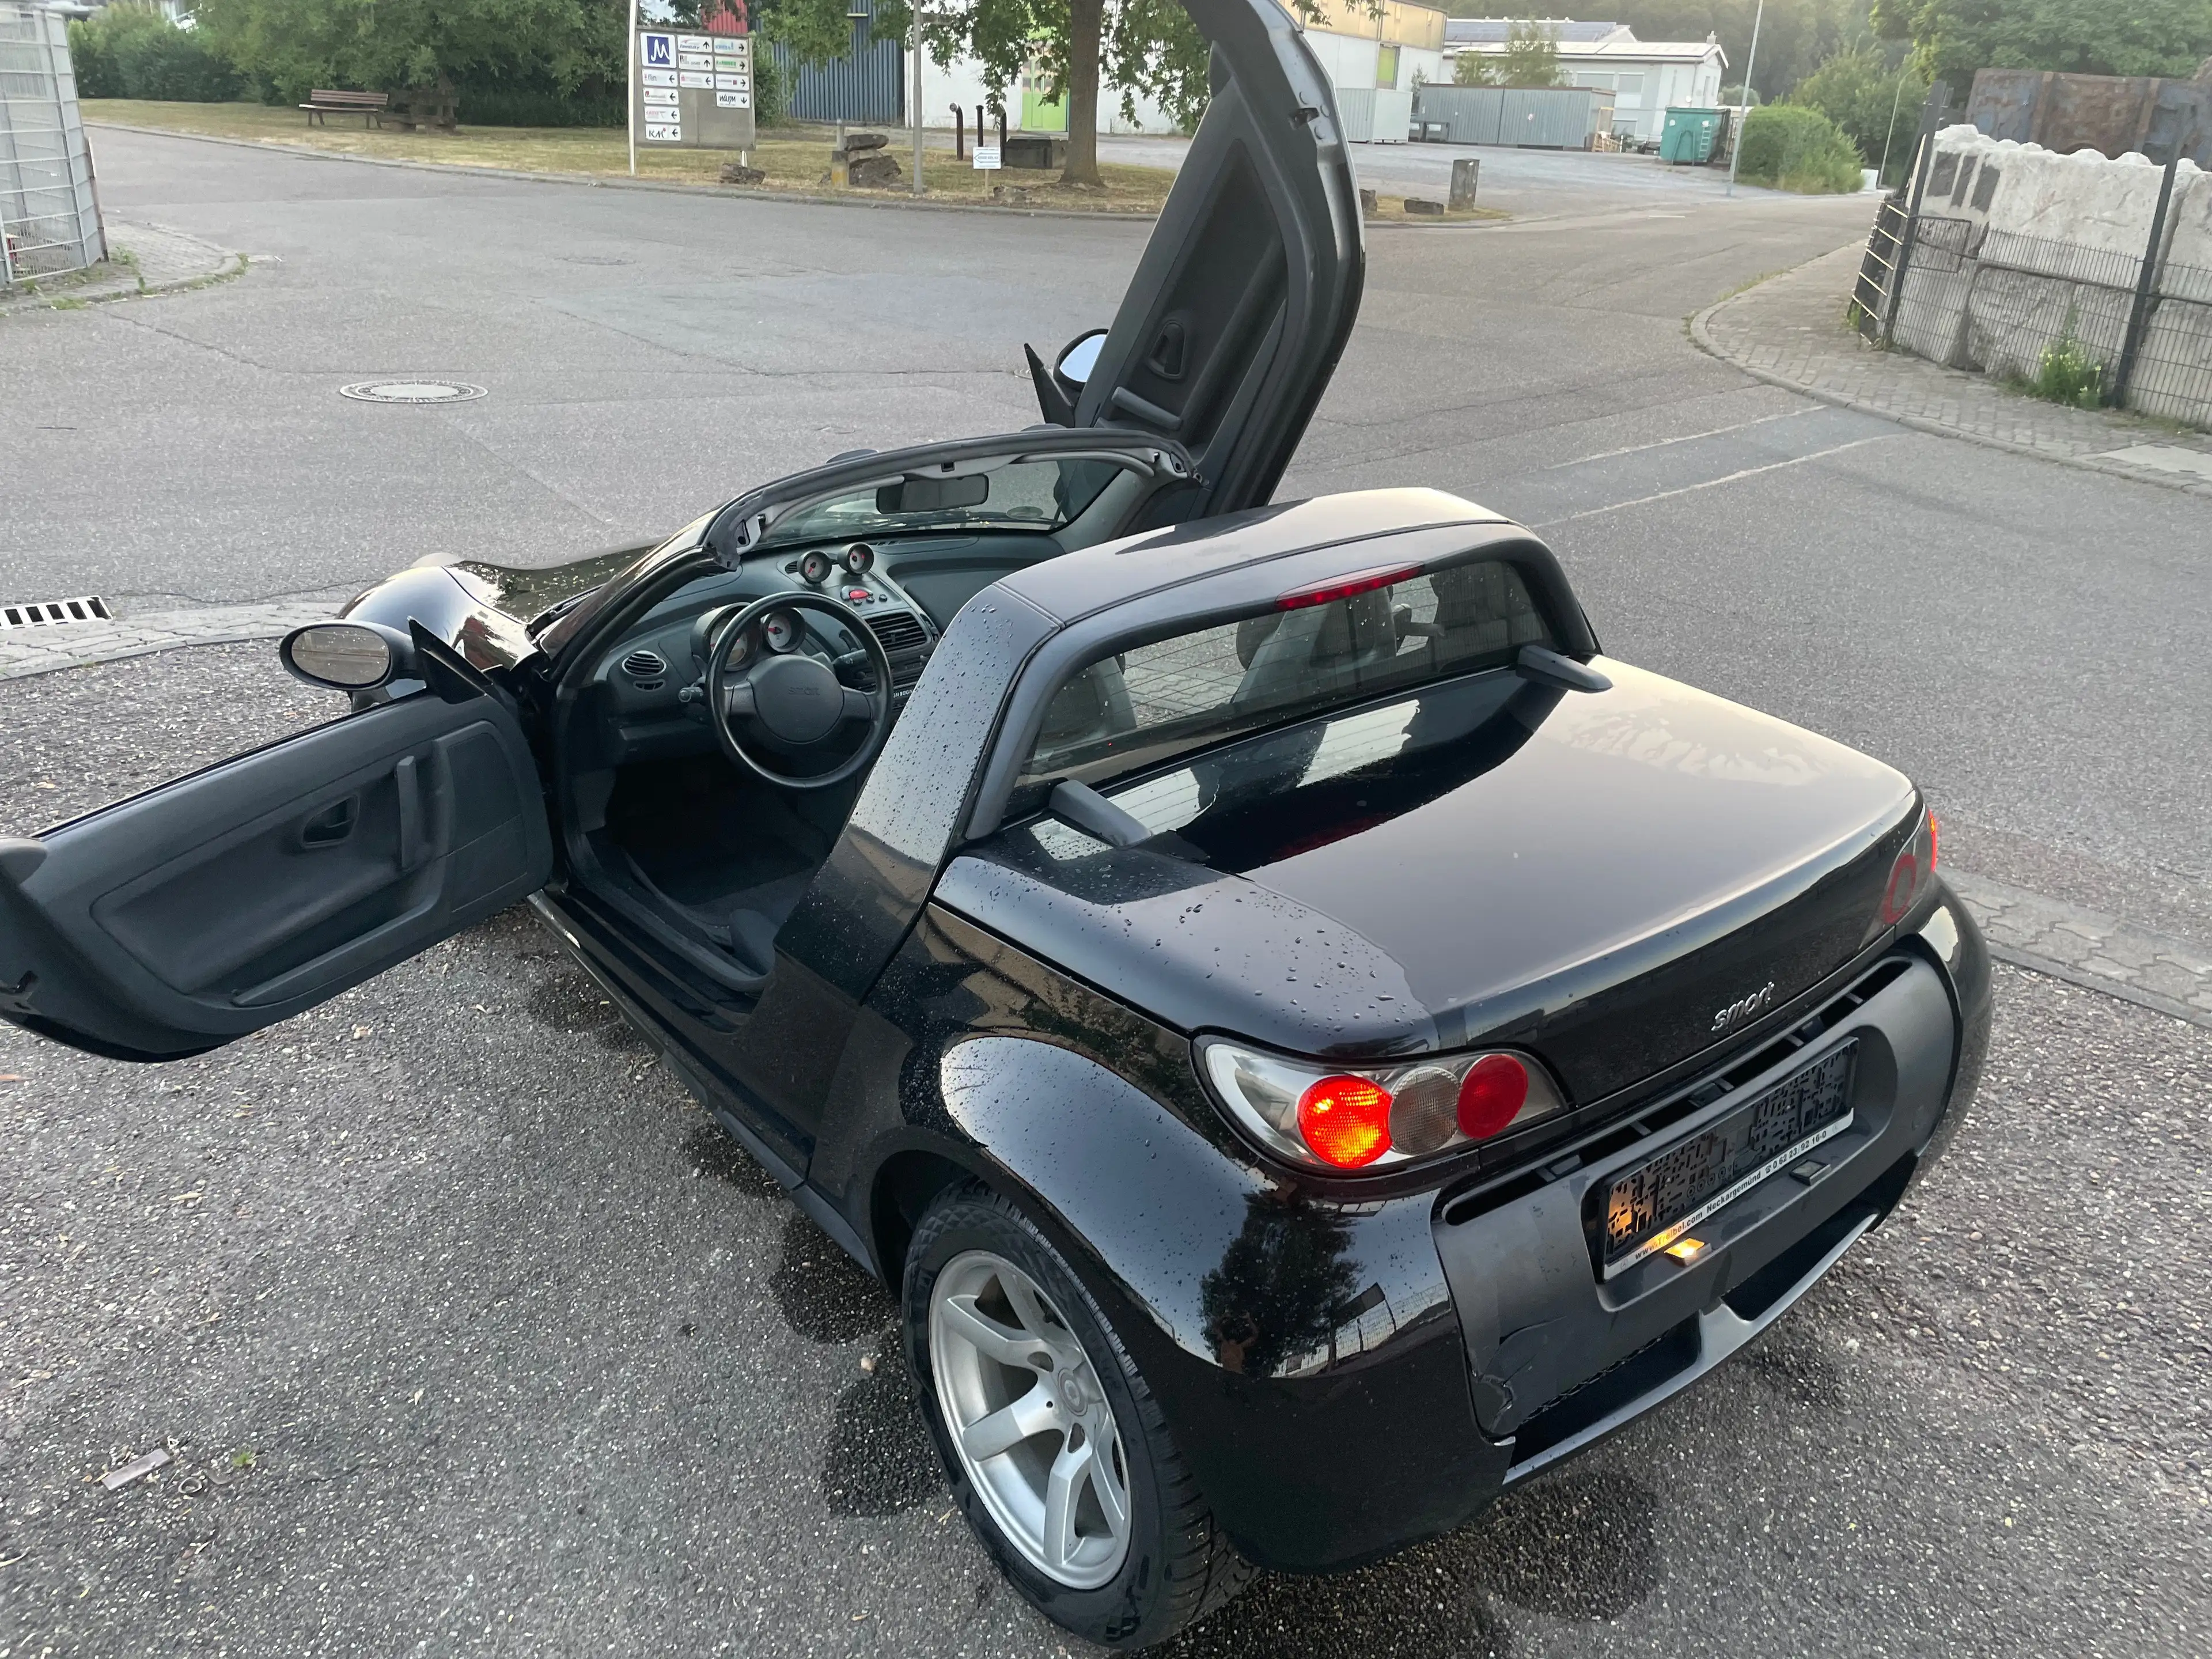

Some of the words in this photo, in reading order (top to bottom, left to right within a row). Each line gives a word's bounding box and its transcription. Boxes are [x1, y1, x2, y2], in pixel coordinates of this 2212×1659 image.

[1711, 981, 1775, 1031] smart
[1706, 1171, 1762, 1214] Neckargemünd
[1779, 1154, 1787, 1165] 62
